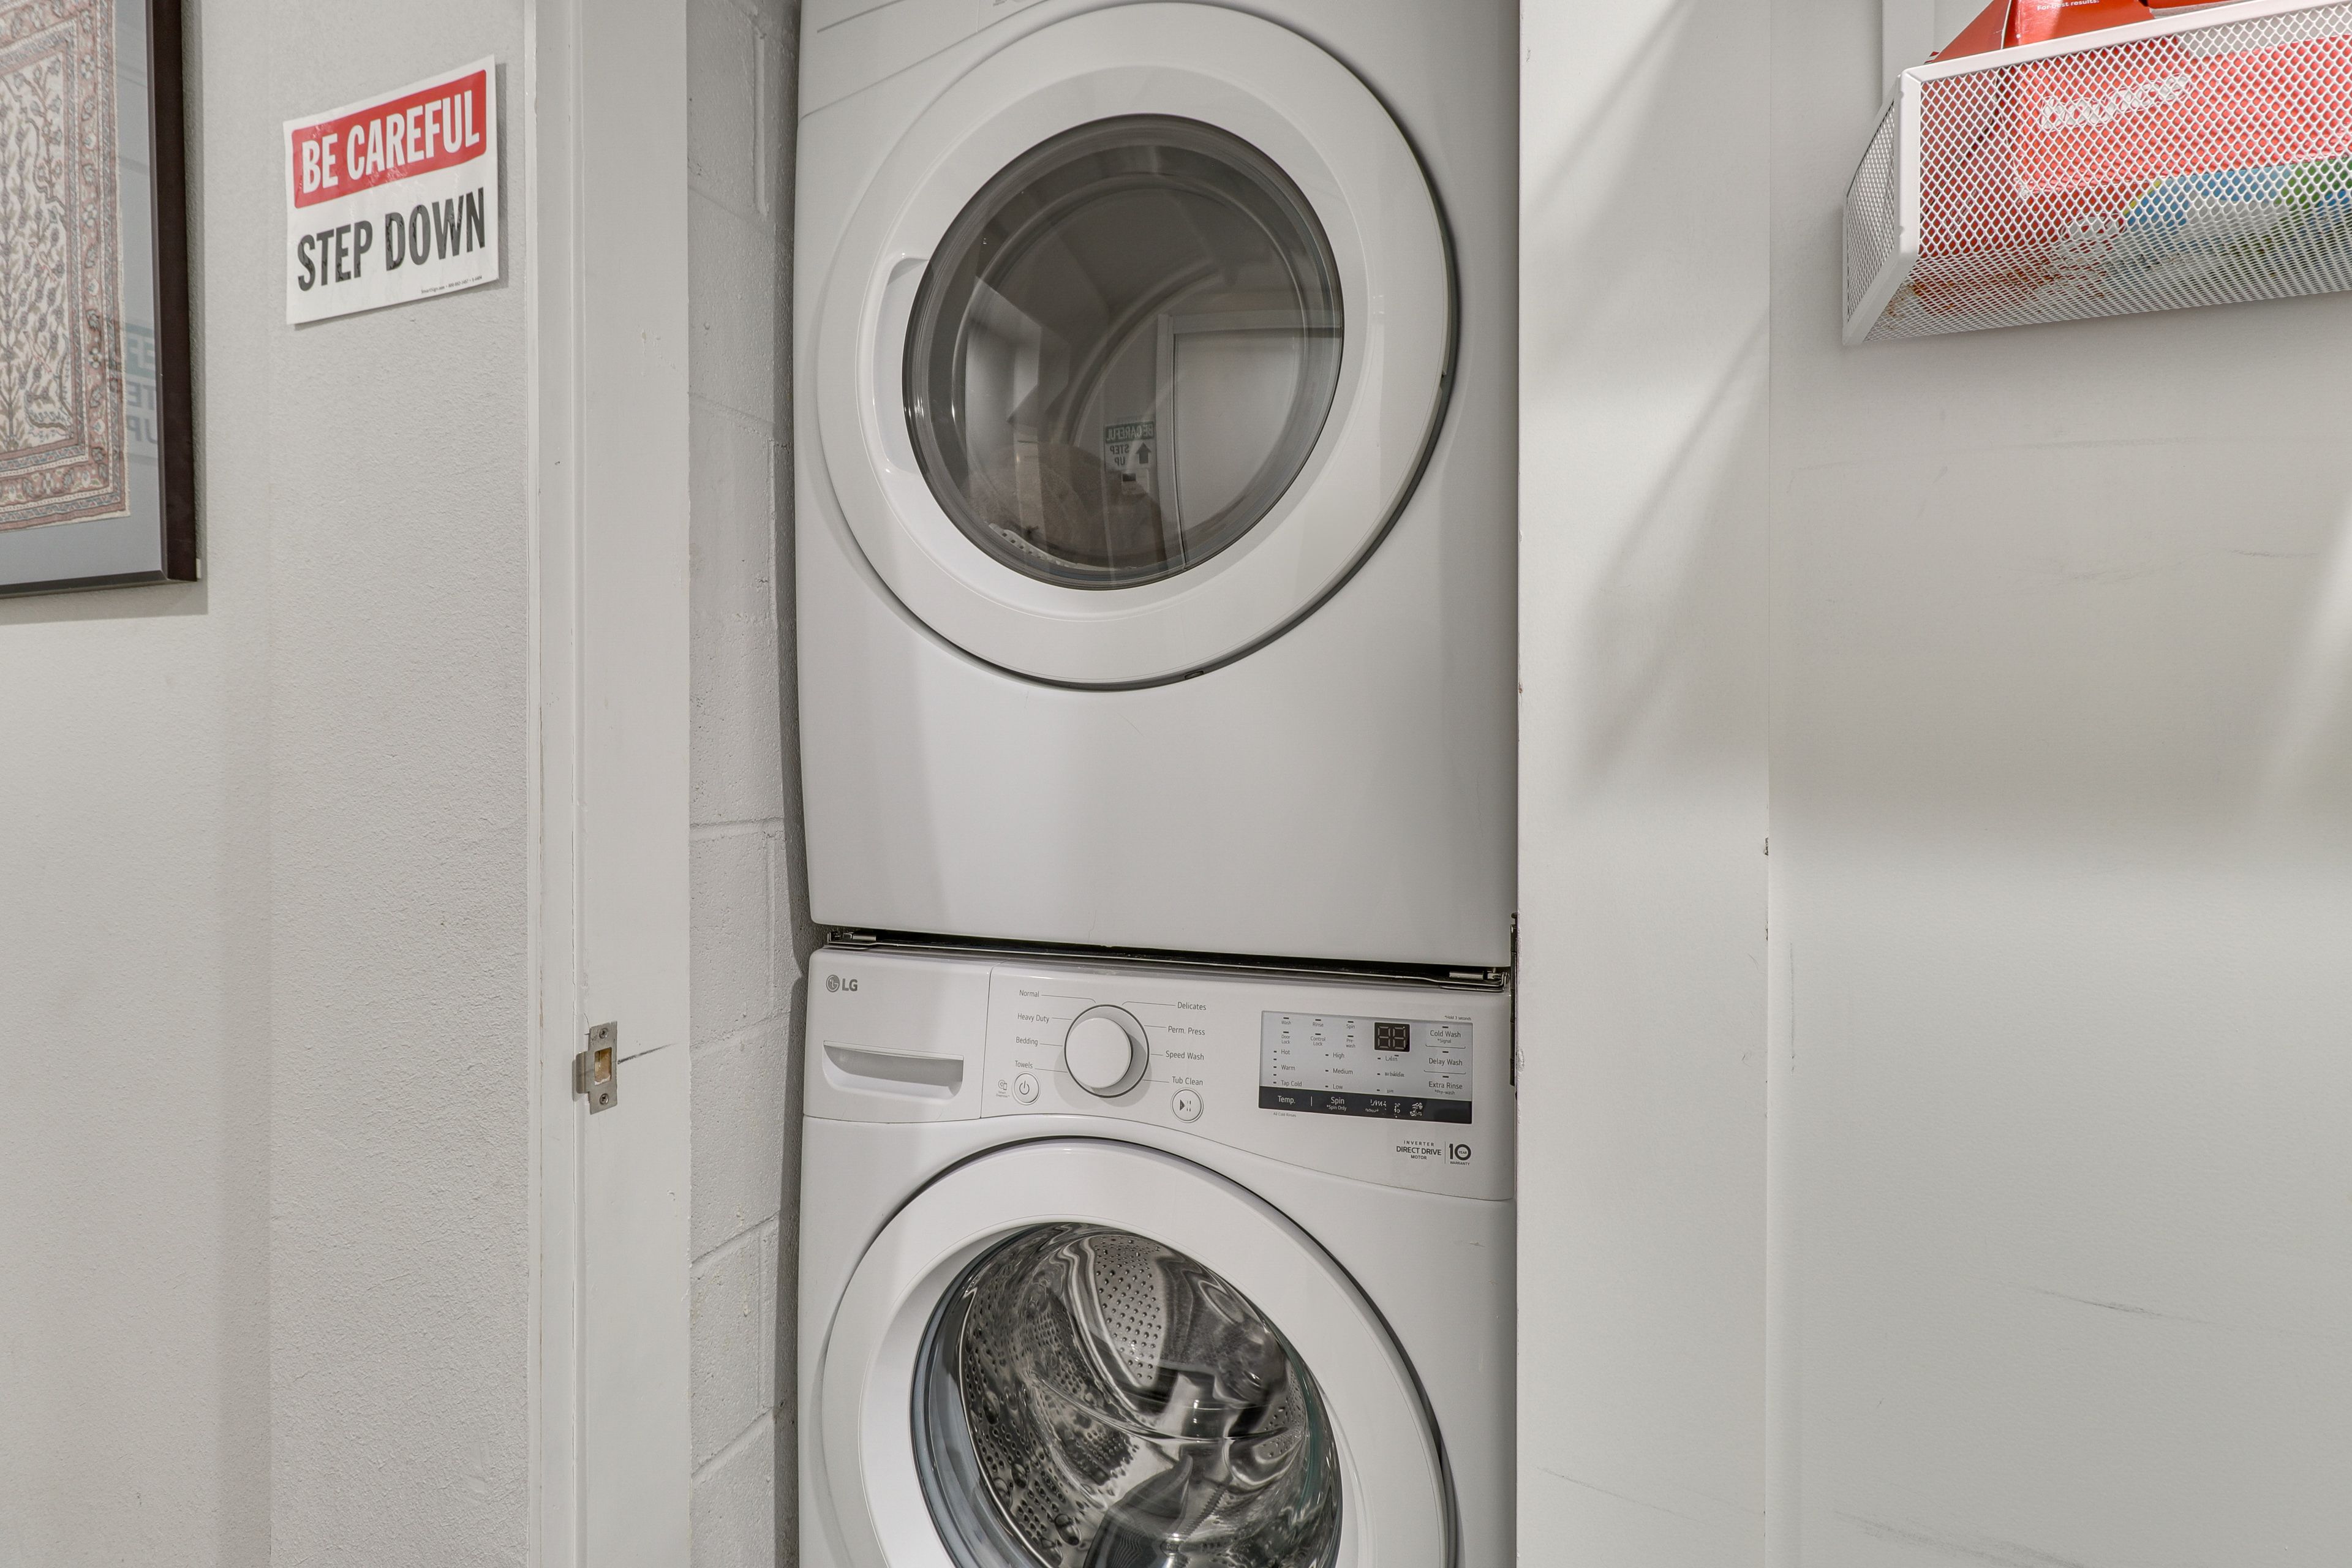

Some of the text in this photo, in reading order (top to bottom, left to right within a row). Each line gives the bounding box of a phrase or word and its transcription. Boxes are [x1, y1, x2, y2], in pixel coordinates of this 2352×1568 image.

[302, 90, 480, 194] BE CAREFUL
[297, 187, 485, 292] STEP DOWN
[842, 978, 858, 992] LG
[1177, 1001, 1207, 1011] Delicates
[1017, 1013, 1049, 1023] Heavy Duty
[1168, 1025, 1186, 1034] Perm.
[1016, 1036, 1038, 1047] Bedding
[1166, 1050, 1185, 1059] Speed
[1015, 1060, 1033, 1069] Towels
[1429, 1058, 1446, 1066] Delay
[1185, 1077, 1204, 1086] Clean
[1278, 1095, 1296, 1106] Temp.
[1330, 1096, 1345, 1106] Spin
[1449, 1144, 1472, 1161] 10
